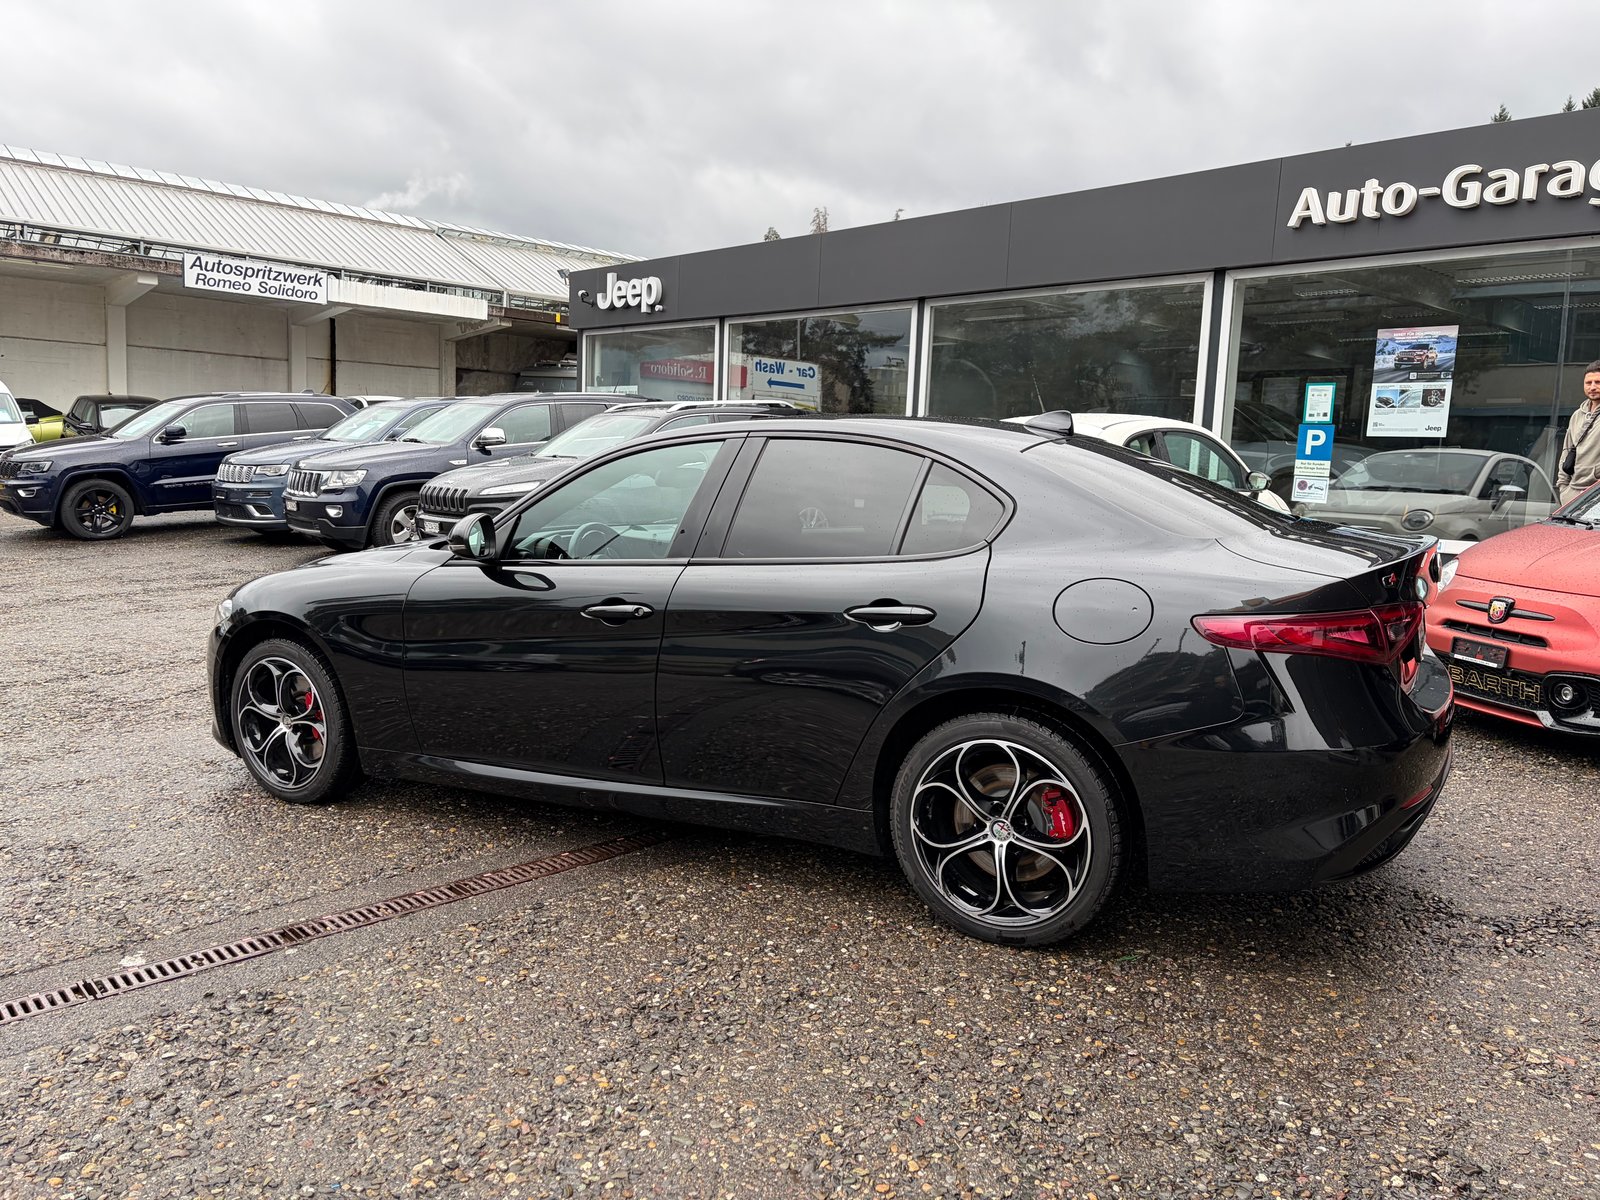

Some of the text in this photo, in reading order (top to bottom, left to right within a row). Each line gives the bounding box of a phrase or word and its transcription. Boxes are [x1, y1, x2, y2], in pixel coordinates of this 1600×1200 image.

[189, 256, 323, 287] Autospritzwerk
[195, 273, 318, 300] Romeo Solidoro
[596, 272, 663, 313] Jeep
[1305, 429, 1327, 455] P
[1448, 664, 1540, 703] BARTH
